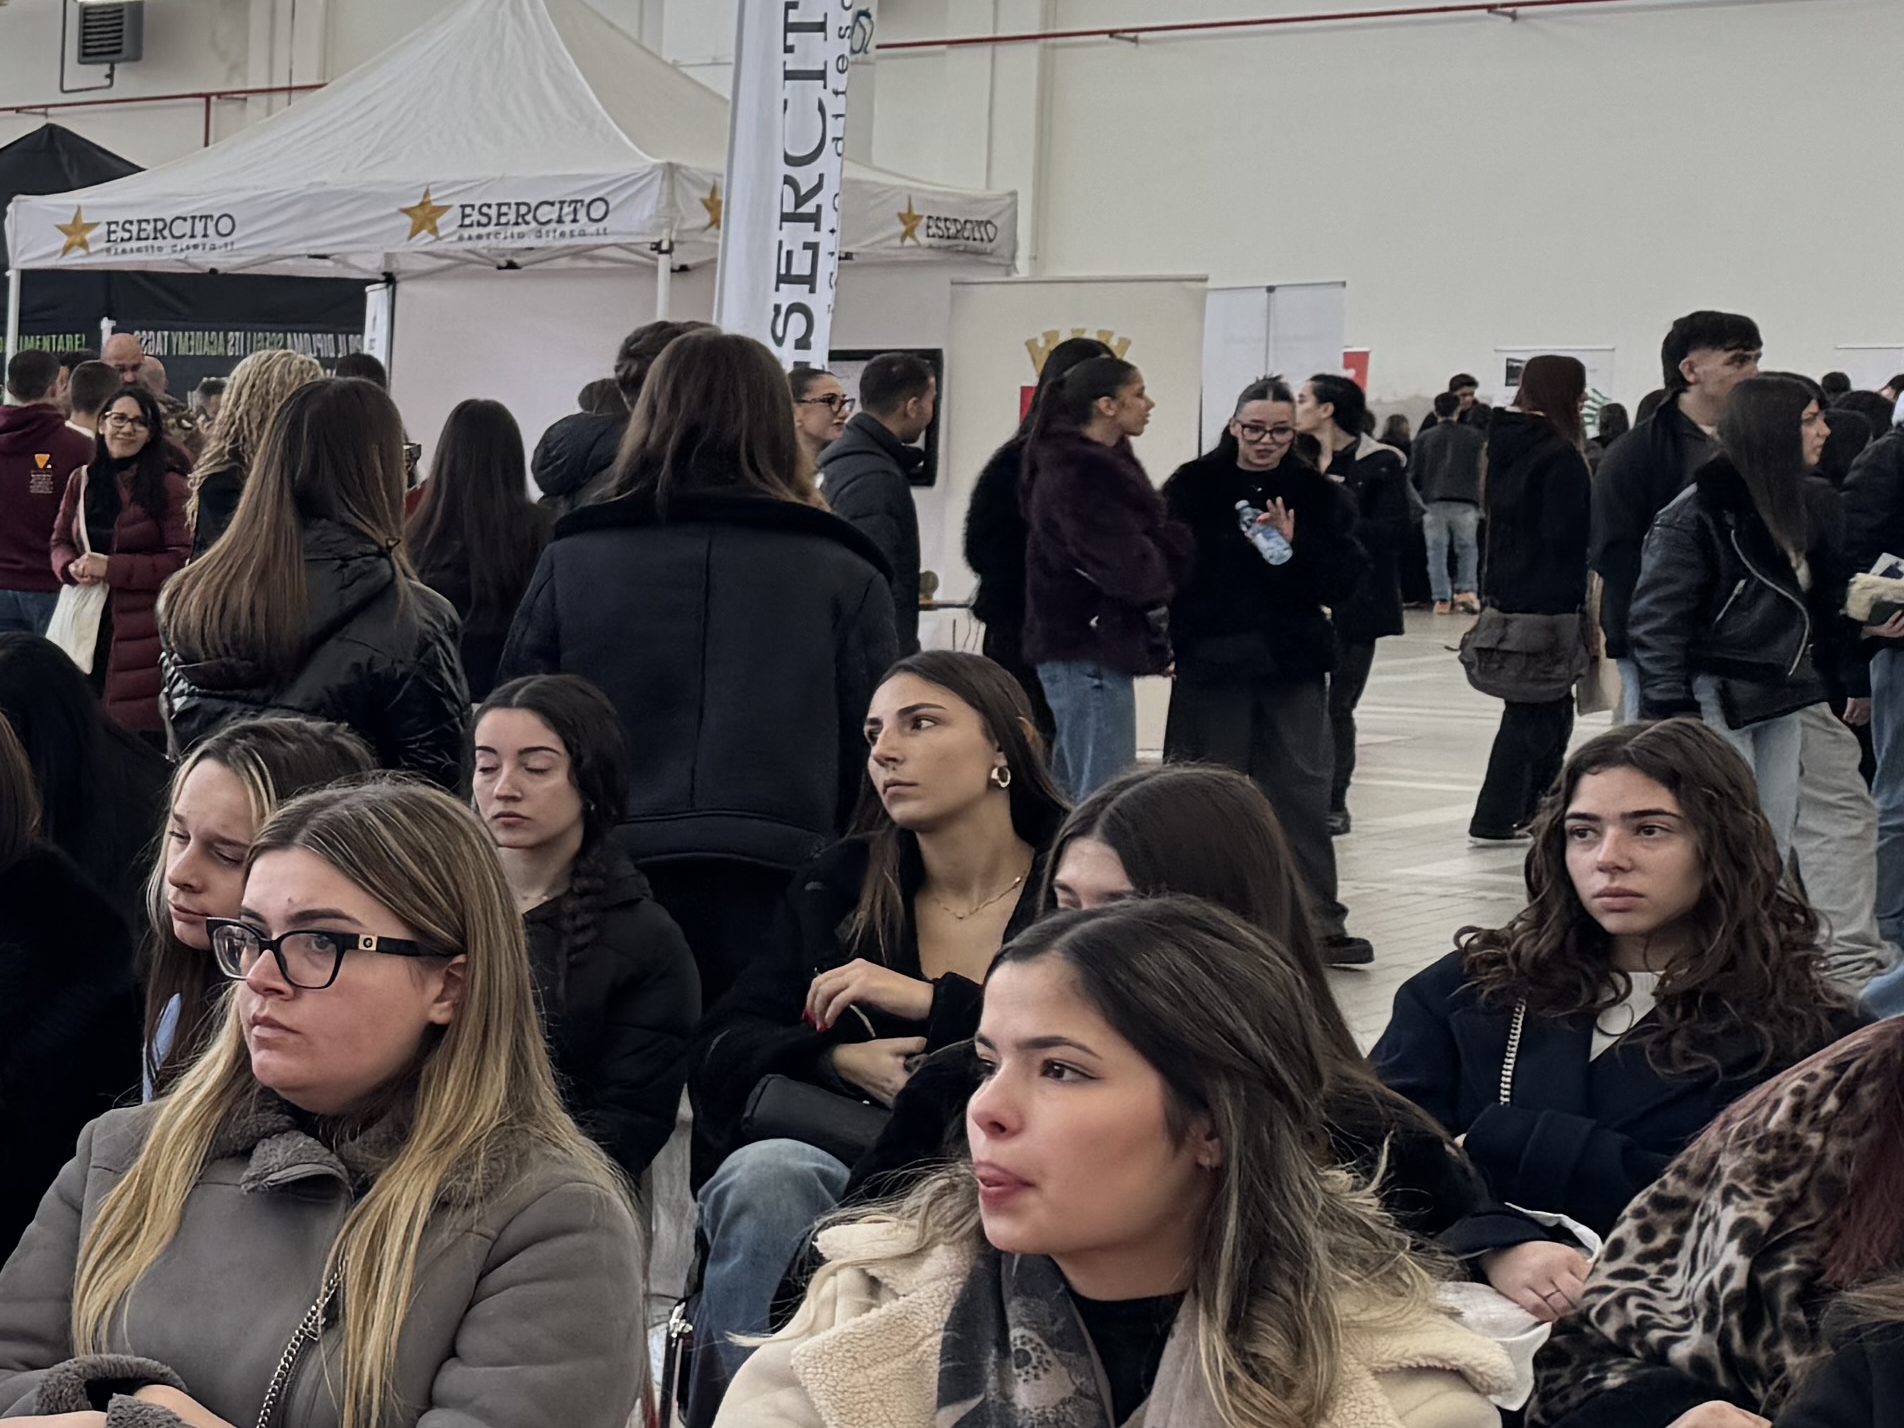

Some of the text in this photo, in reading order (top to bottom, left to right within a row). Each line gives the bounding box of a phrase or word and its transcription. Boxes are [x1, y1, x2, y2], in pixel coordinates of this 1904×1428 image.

[105, 213, 236, 244] ESERCITO
[457, 197, 610, 229] ESERCITO
[926, 215, 998, 242] ESERCITO
